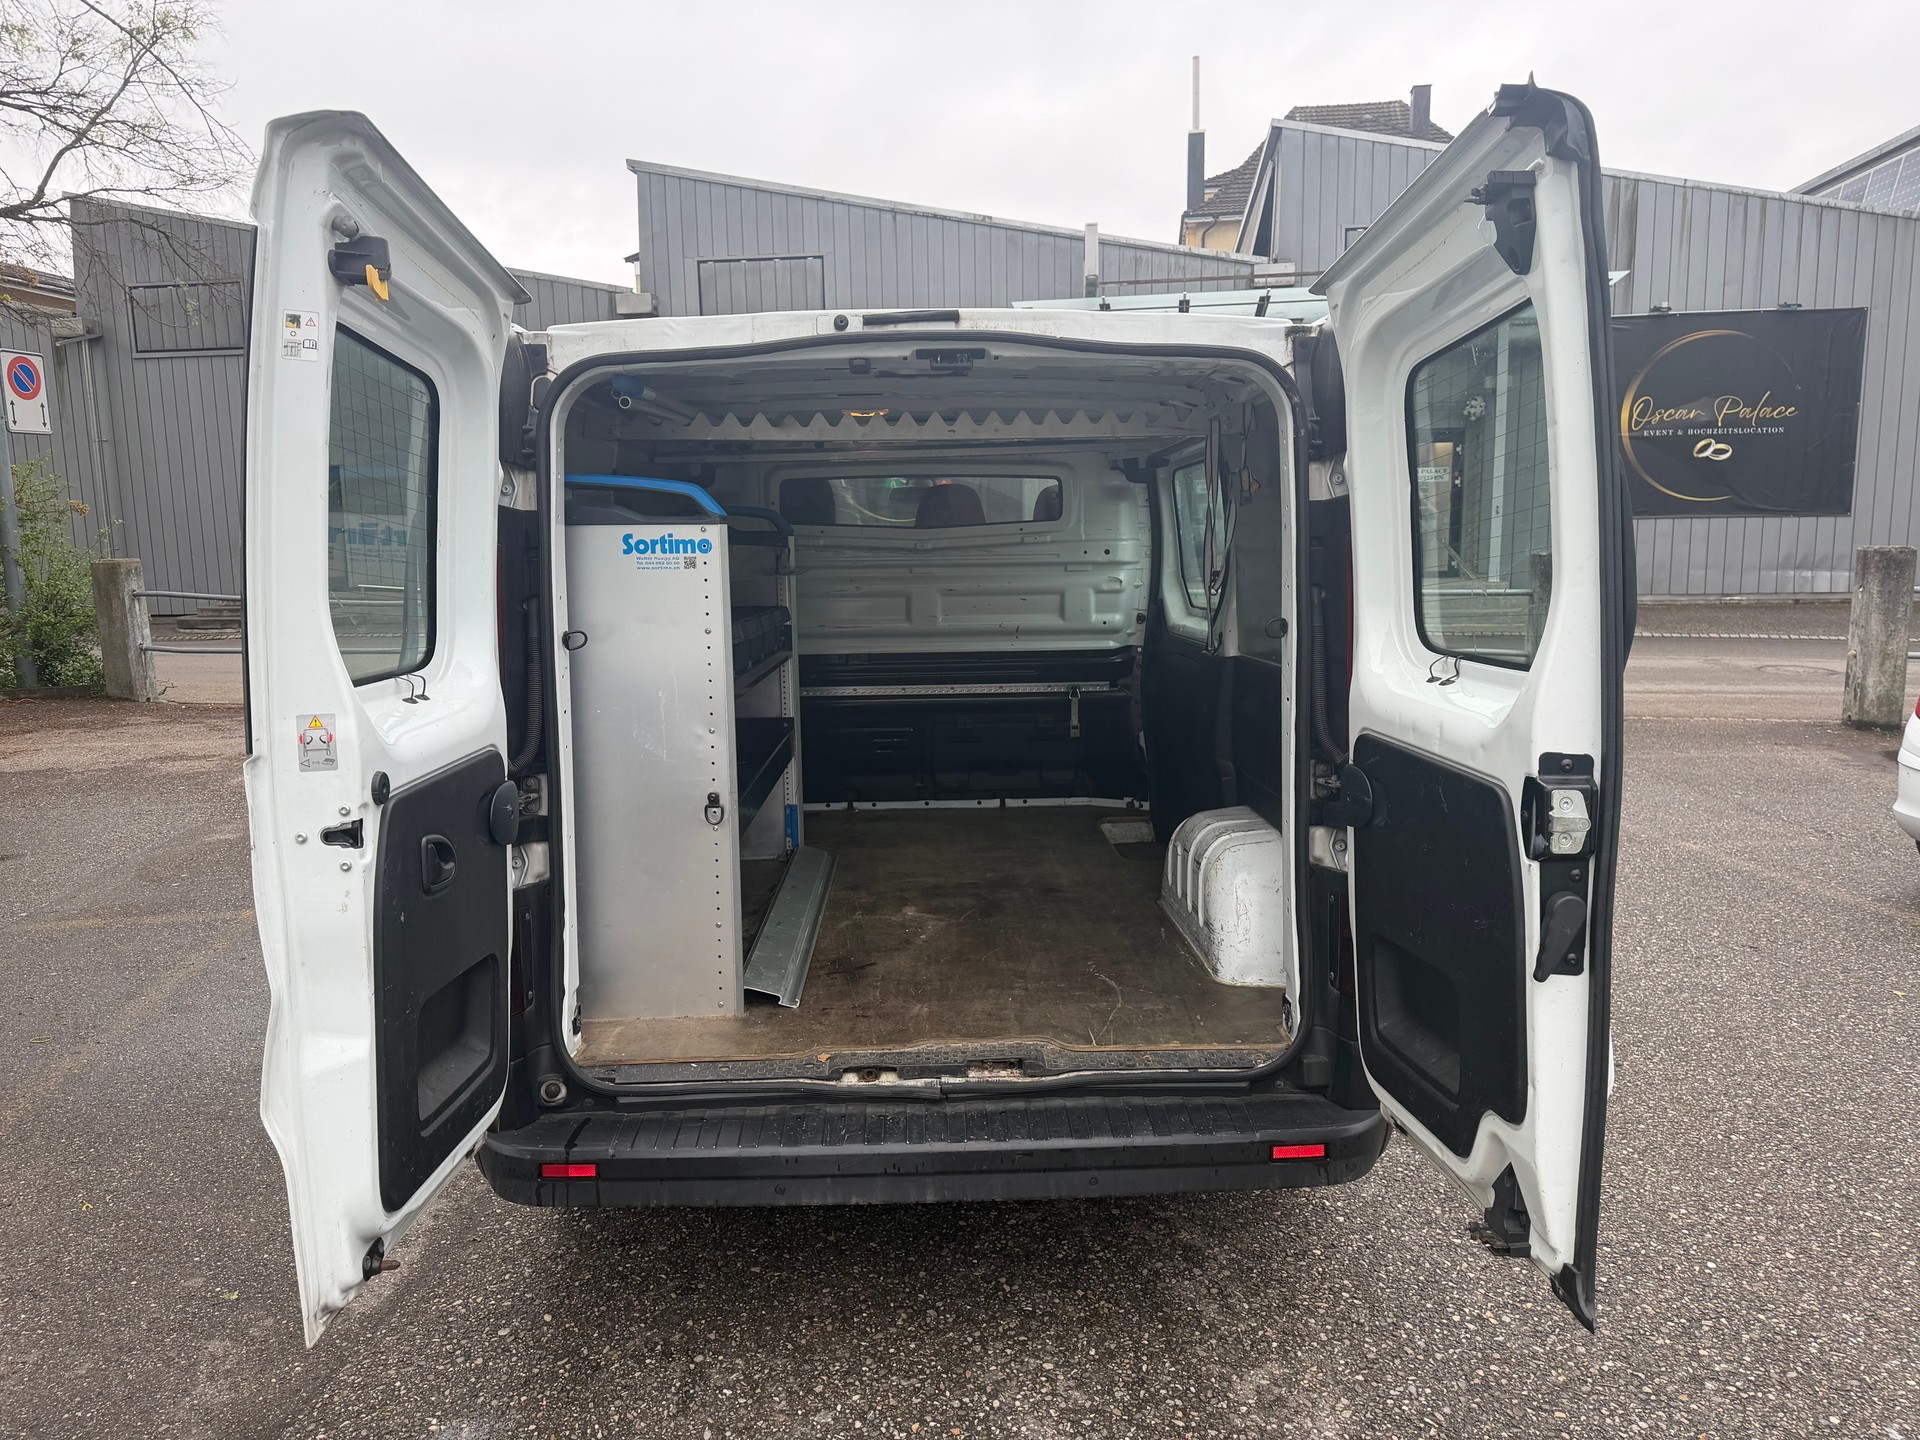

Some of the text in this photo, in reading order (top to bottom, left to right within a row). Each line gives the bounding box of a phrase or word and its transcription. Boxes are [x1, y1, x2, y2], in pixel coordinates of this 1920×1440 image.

[1631, 390, 1798, 431] Oscar Palace
[1643, 429, 1674, 437] EVENT
[1687, 426, 1785, 436] HOCHZEITSLOCATION
[622, 532, 713, 555] Sortimo
